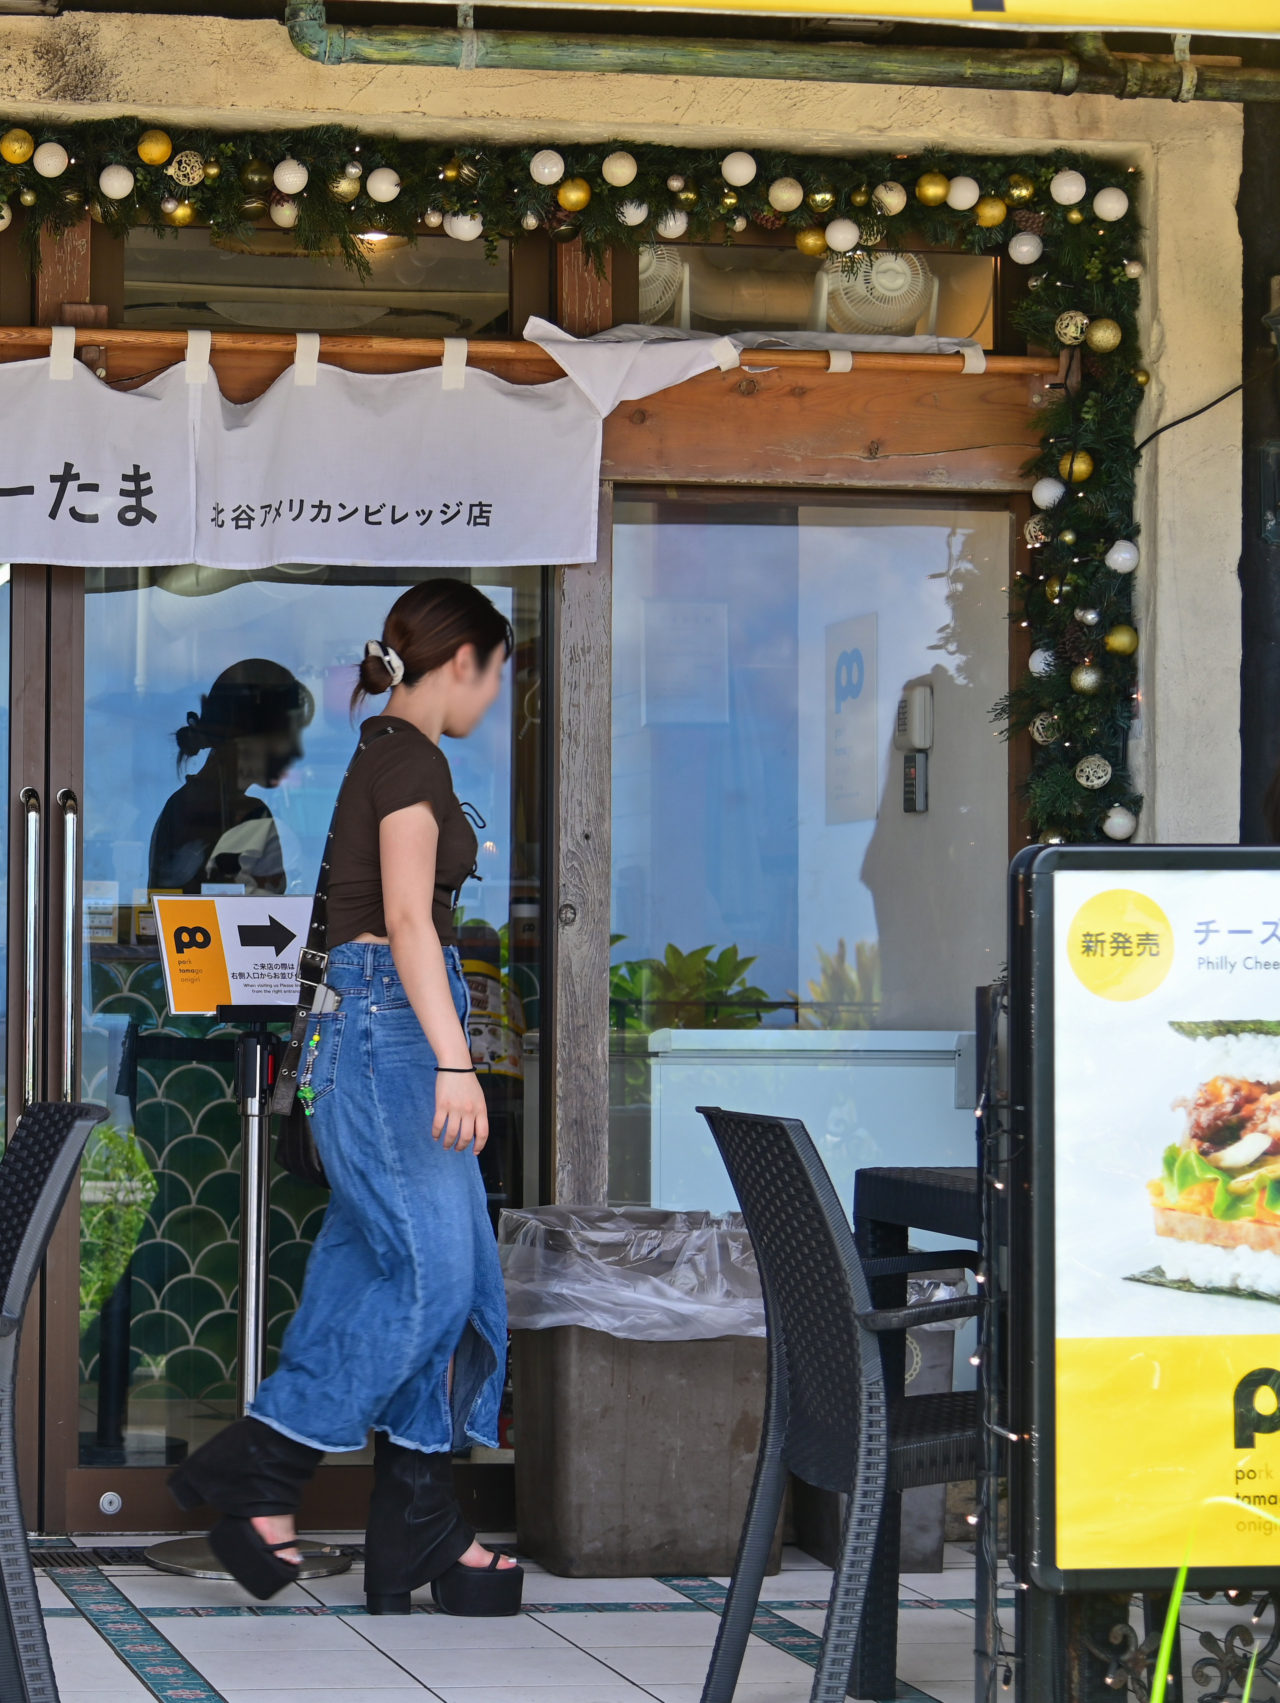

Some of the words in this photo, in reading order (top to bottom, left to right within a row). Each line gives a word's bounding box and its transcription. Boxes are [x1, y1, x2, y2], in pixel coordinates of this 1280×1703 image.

[210, 498, 493, 530] 北谷アメリカンビレッジ店
[1081, 932, 1160, 957] 新発売
[1197, 956, 1237, 974] Philly
[1235, 1463, 1274, 1485] pork
